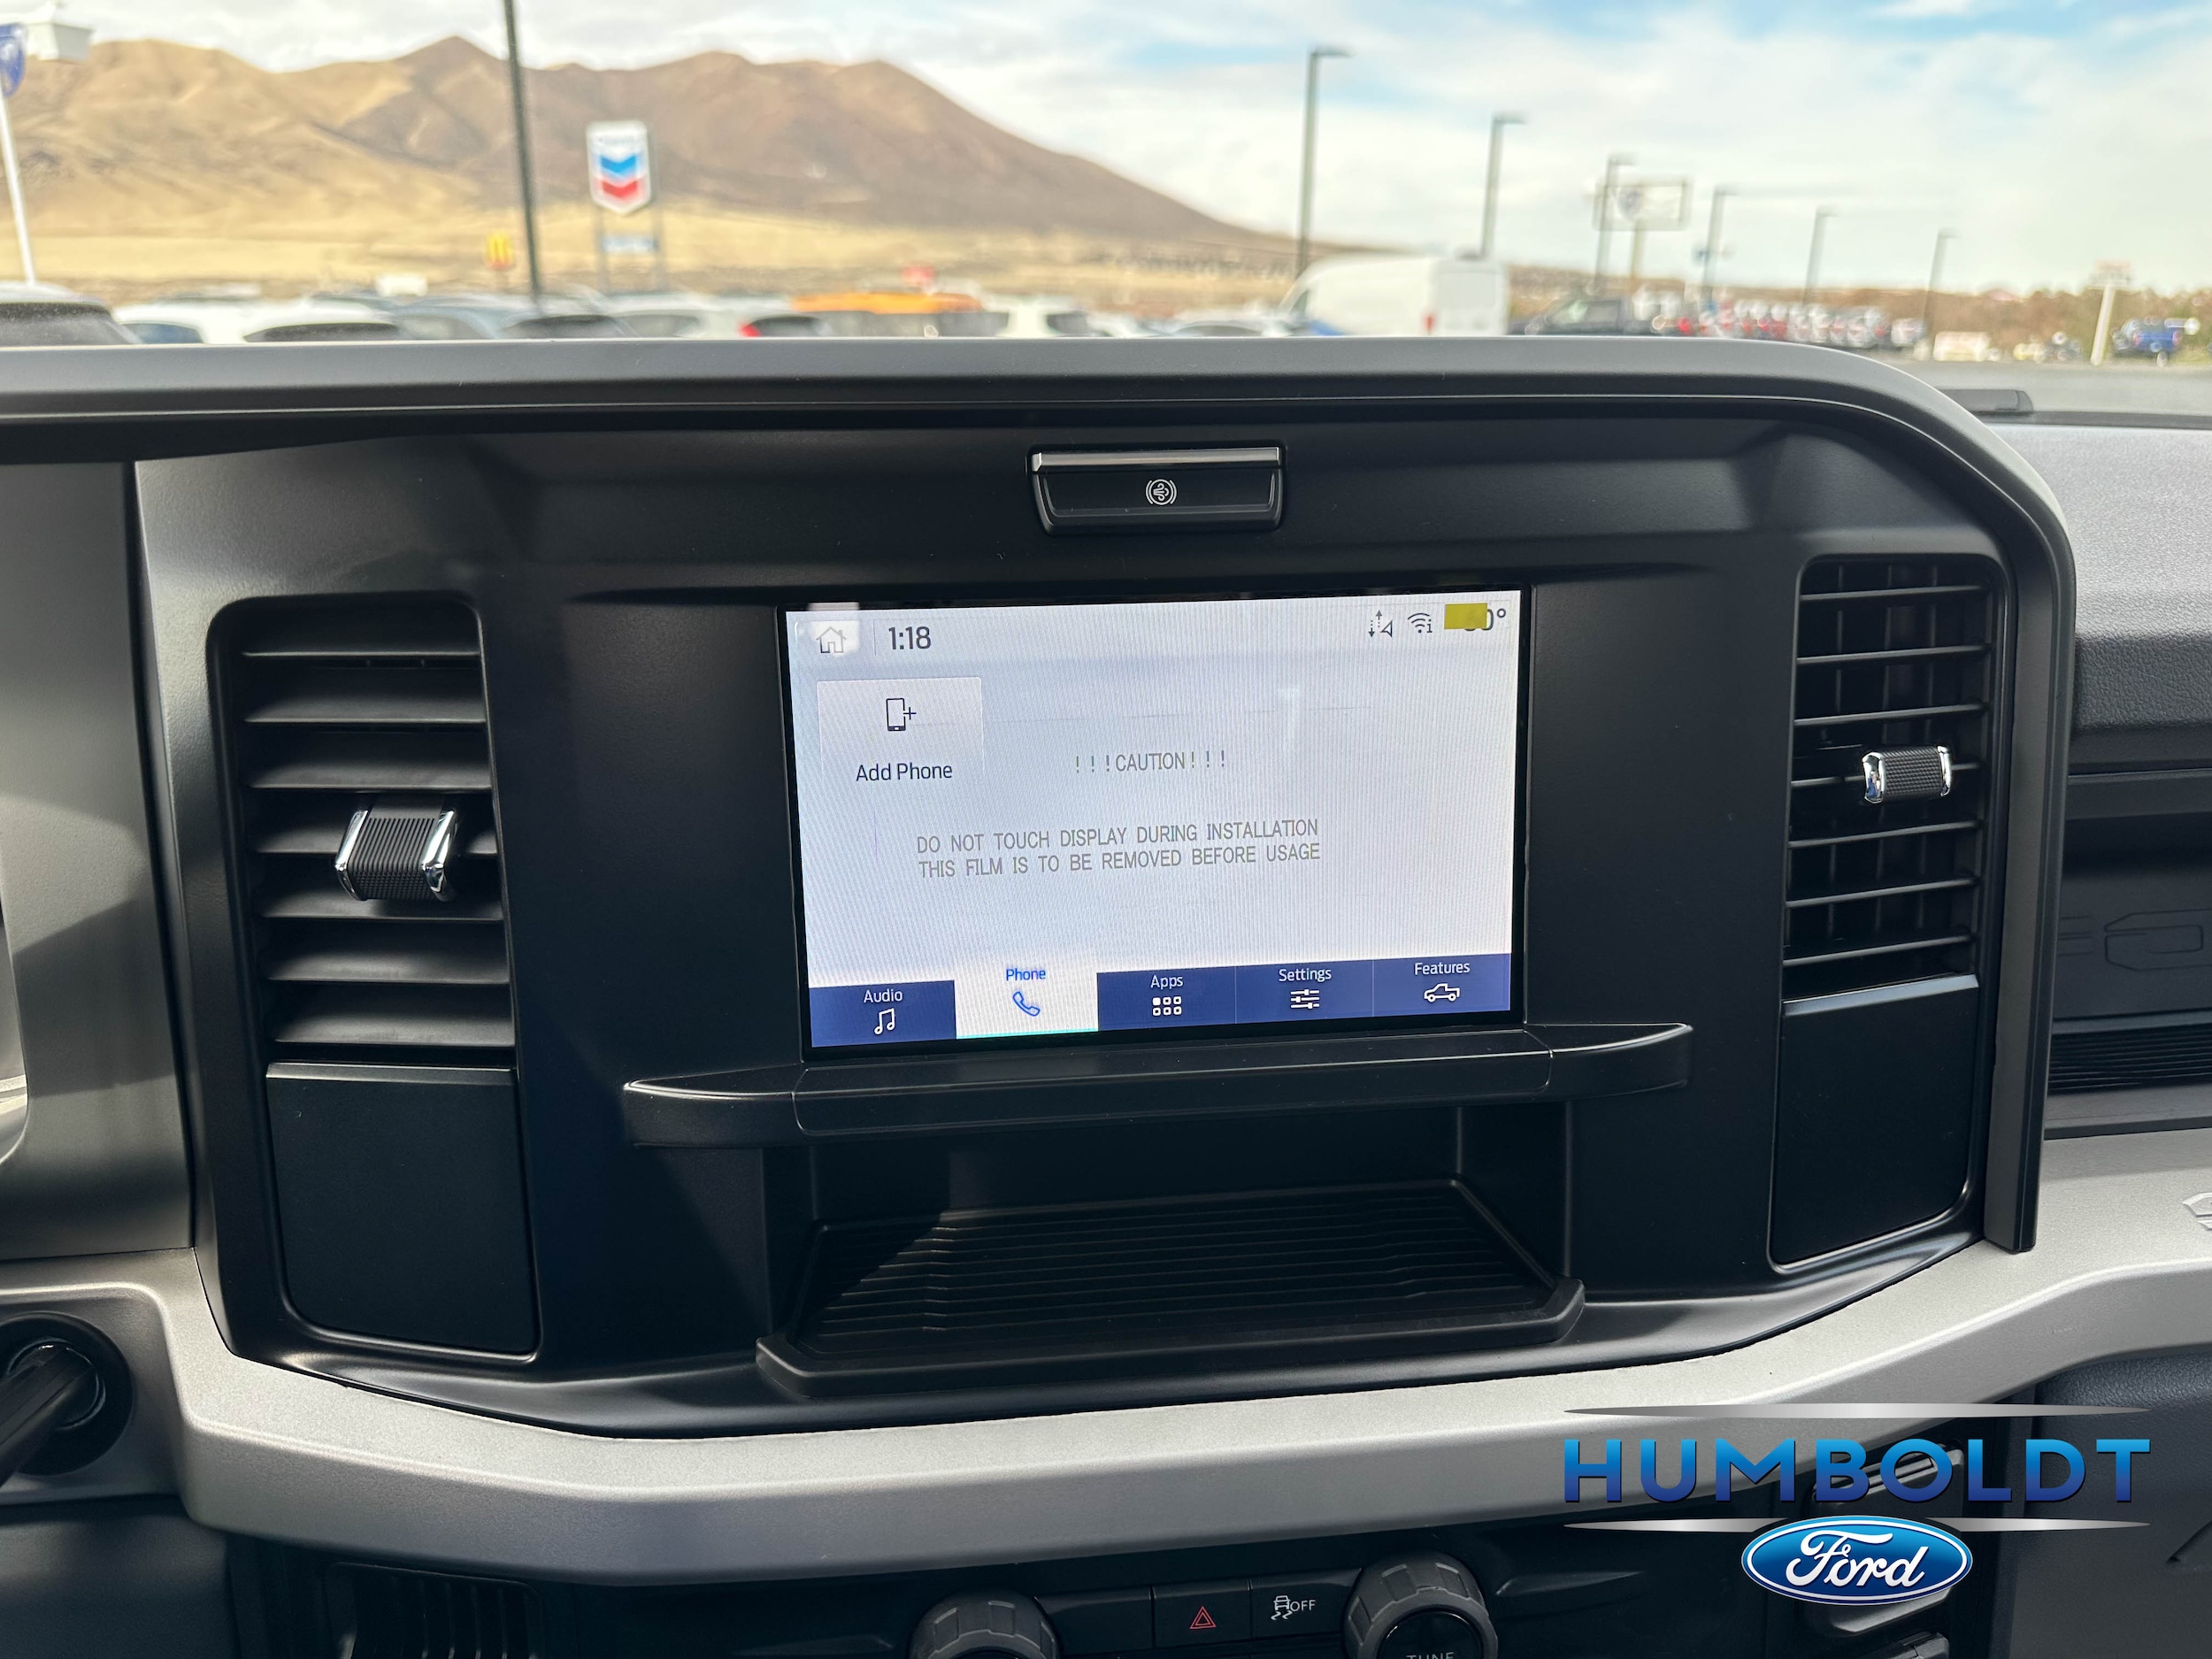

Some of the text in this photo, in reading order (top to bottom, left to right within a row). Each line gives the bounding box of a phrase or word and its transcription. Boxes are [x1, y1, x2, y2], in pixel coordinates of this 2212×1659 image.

[888, 626, 932, 650] 1:18
[856, 762, 953, 781] Add Phone
[917, 818, 1318, 853] DO NOT TOUCH DISPLAY DURING INSTALLATION
[918, 842, 1321, 878] THIS FILM IS TO BE REMOVED BEFORE USAGE
[1006, 967, 1046, 981] Phone
[1279, 967, 1332, 983] Settings
[1414, 961, 1471, 976] Features
[1150, 974, 1183, 989] Apps
[863, 988, 903, 1004] Audio
[1289, 1599, 1317, 1612] OFF
